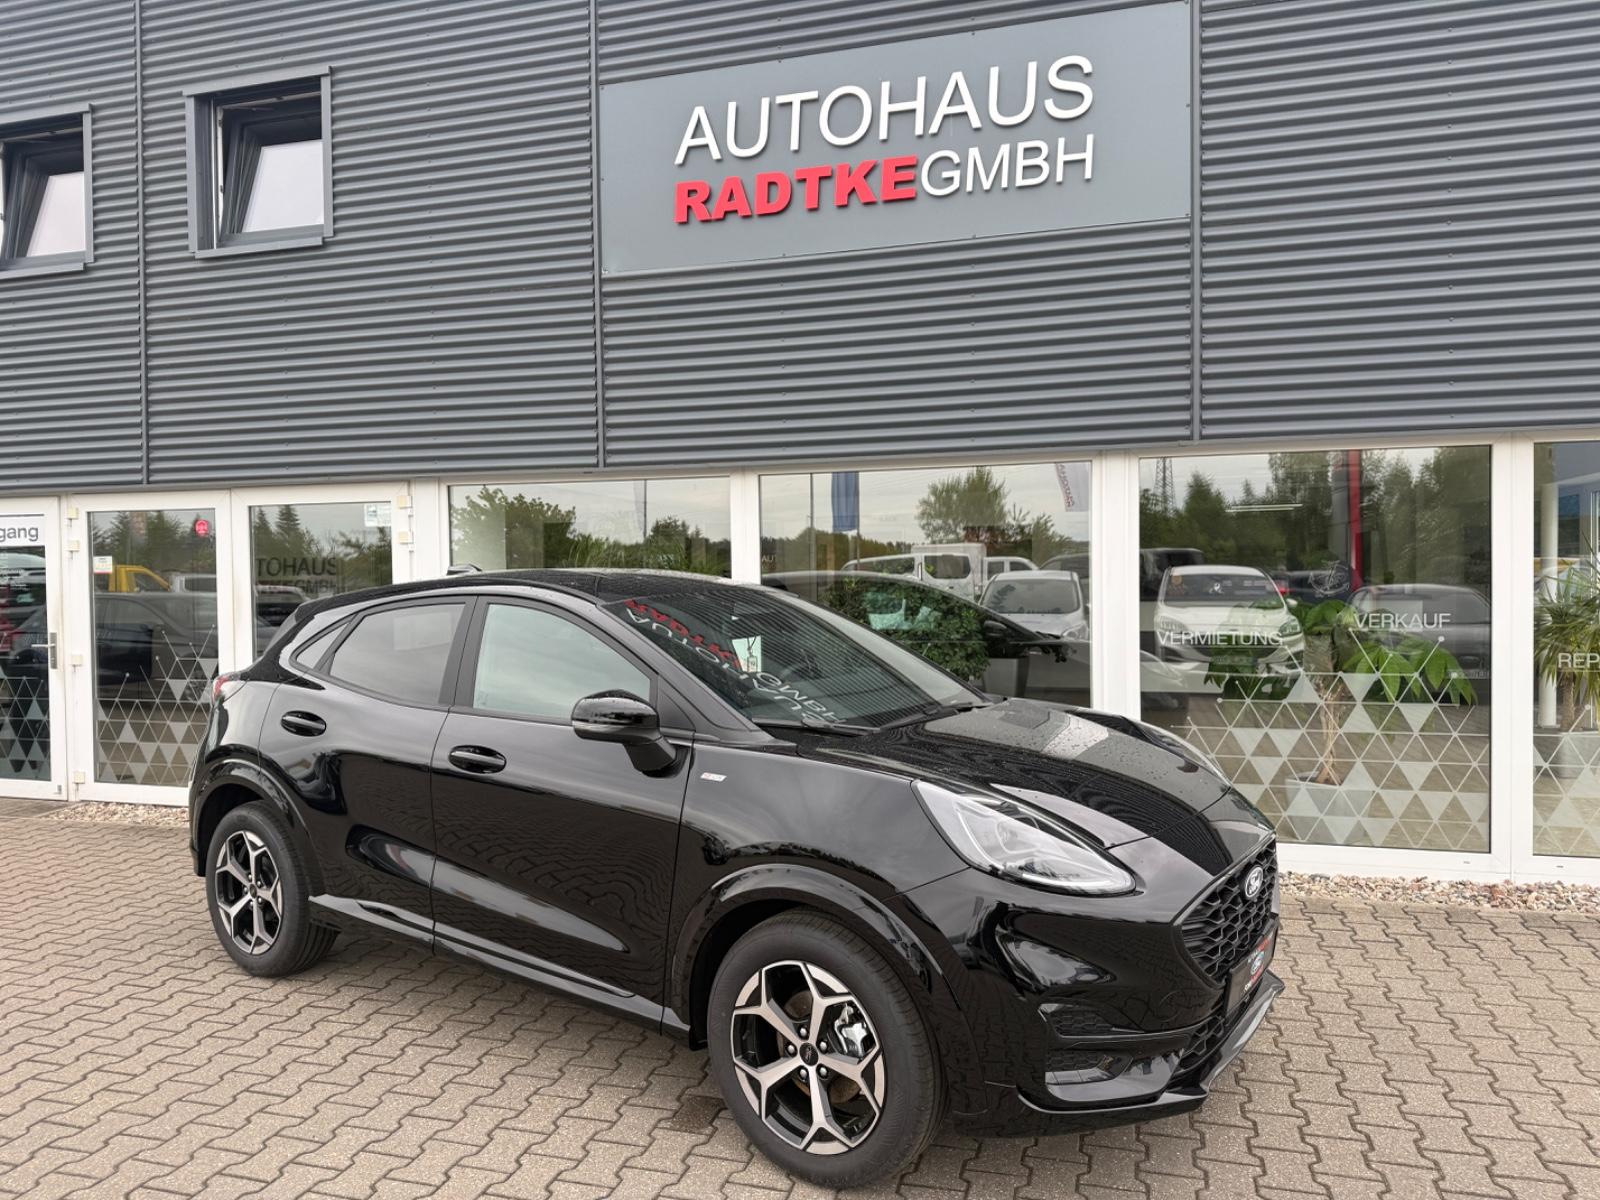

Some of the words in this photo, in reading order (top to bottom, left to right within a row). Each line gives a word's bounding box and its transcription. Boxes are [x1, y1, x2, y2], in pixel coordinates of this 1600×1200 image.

[674, 54, 1095, 165] AUTOHAUS
[1353, 612, 1452, 630] VERKAUF
[1156, 630, 1284, 646] VERMIETUNG
